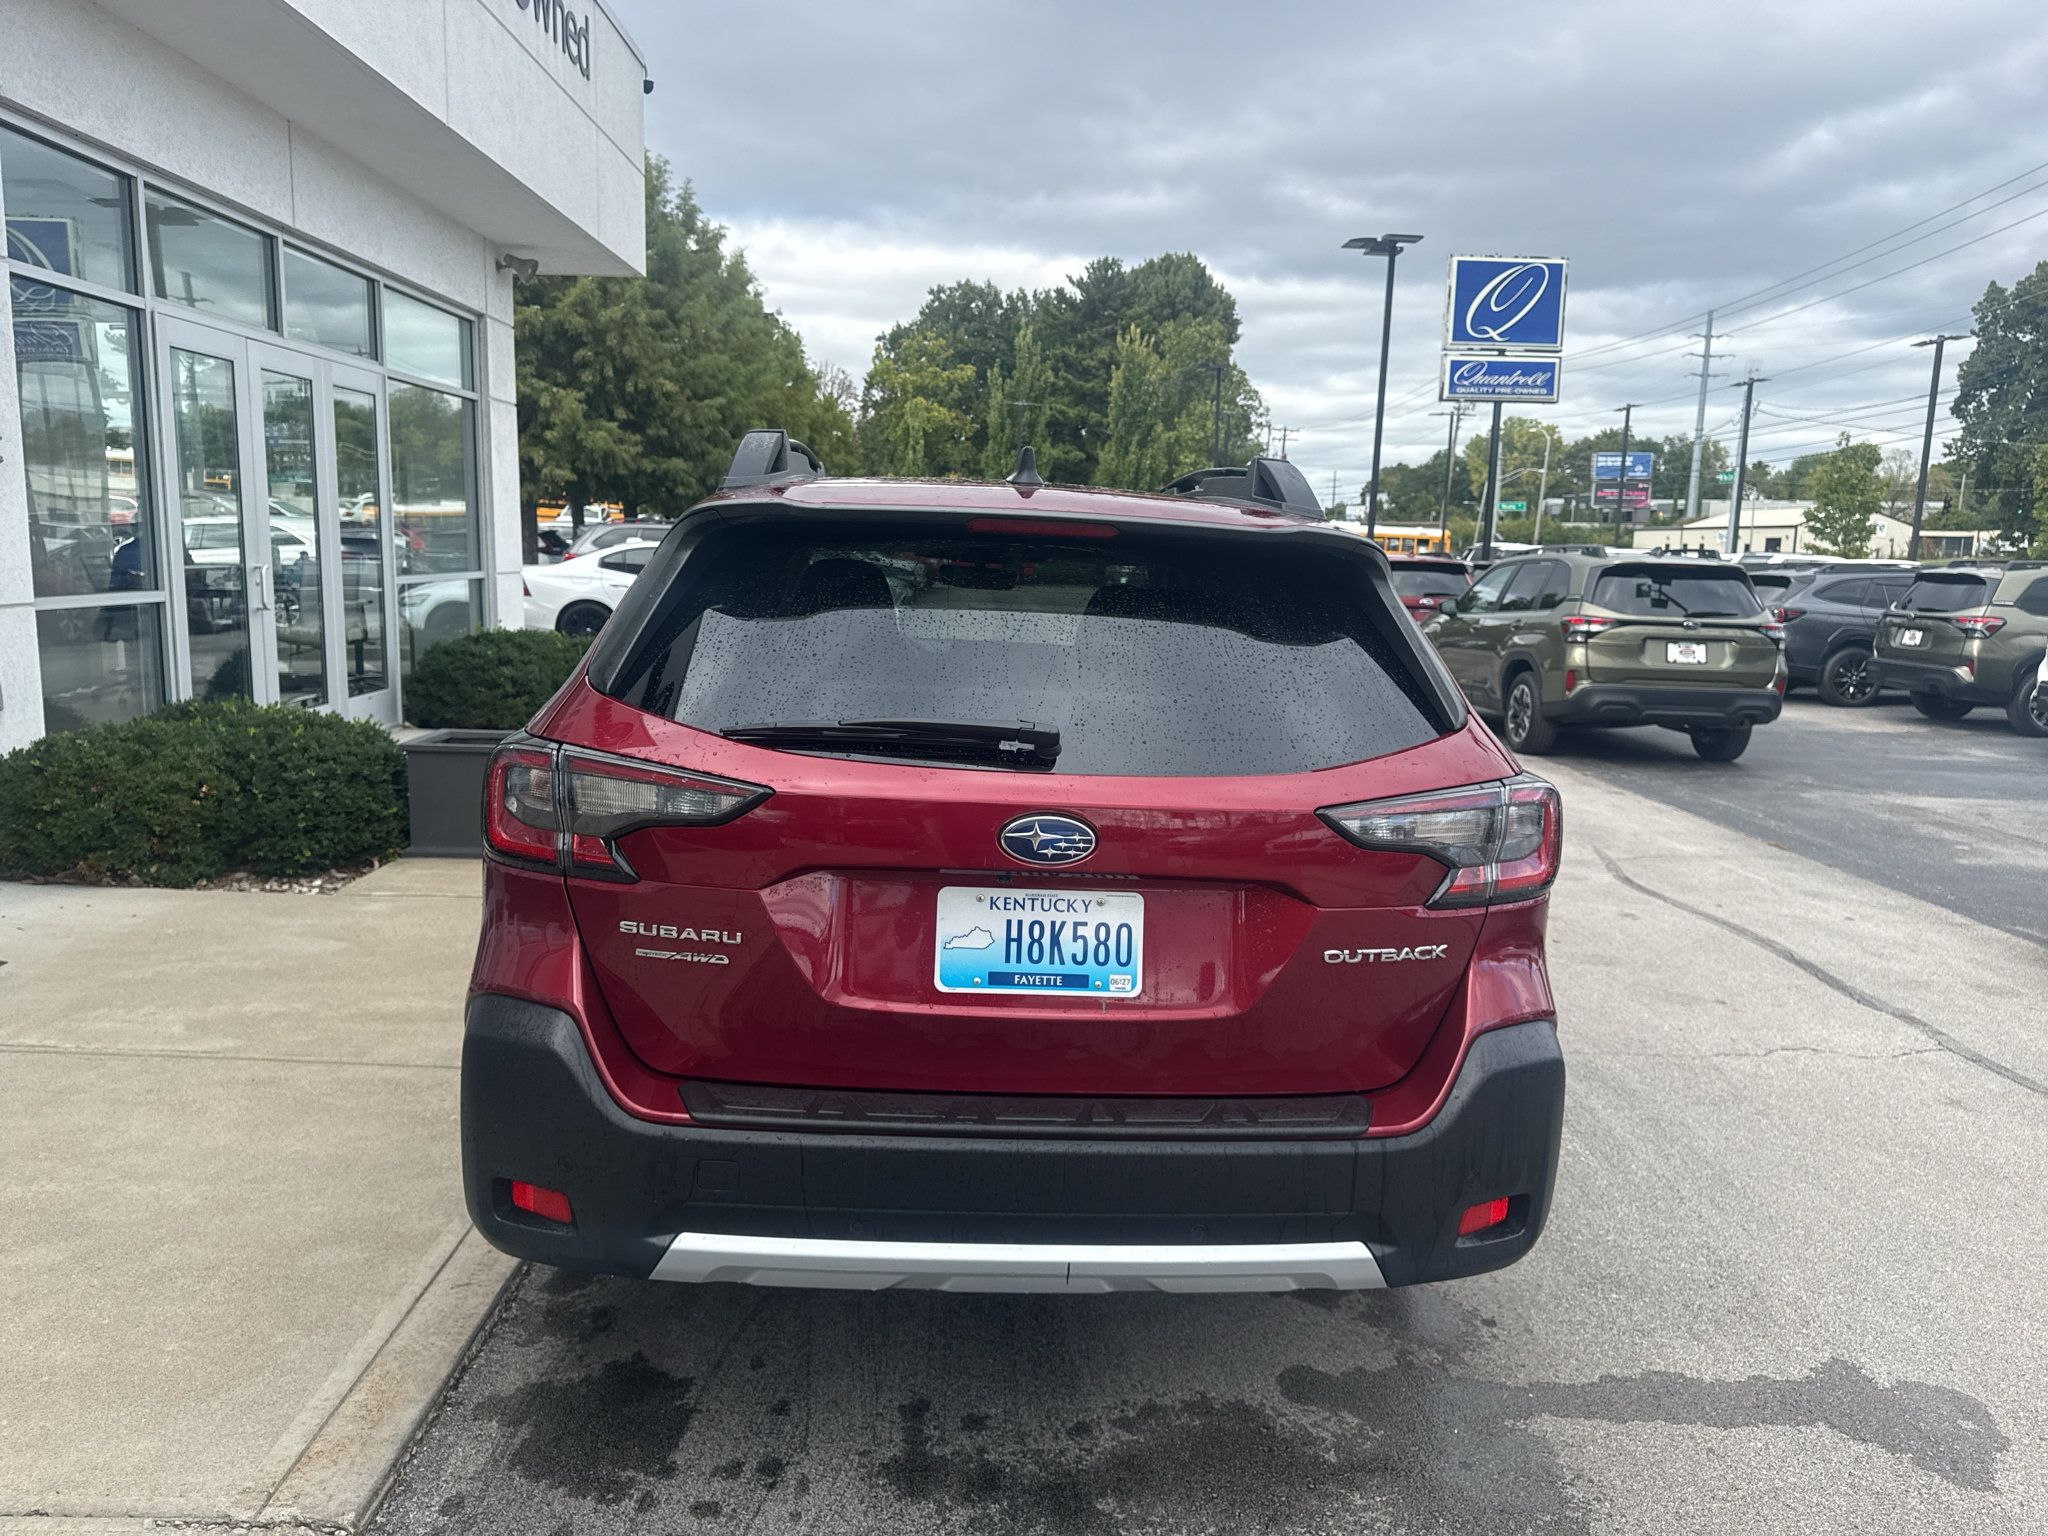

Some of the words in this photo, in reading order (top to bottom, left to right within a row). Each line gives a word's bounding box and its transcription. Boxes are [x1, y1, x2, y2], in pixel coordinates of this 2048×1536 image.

[515, 0, 591, 82] wned
[1465, 262, 1549, 342] Q
[1454, 361, 1551, 385] Quantrell
[1456, 386, 1493, 394] QUALITY
[1495, 387, 1548, 395] PRE-OWNED
[989, 896, 1093, 913] KENTUCKY
[619, 920, 742, 945] SUBARU
[1004, 919, 1133, 968] H8K580
[670, 952, 730, 965] AWD
[1323, 943, 1448, 964] OUTBACK
[1014, 975, 1064, 986] FAYETTE
